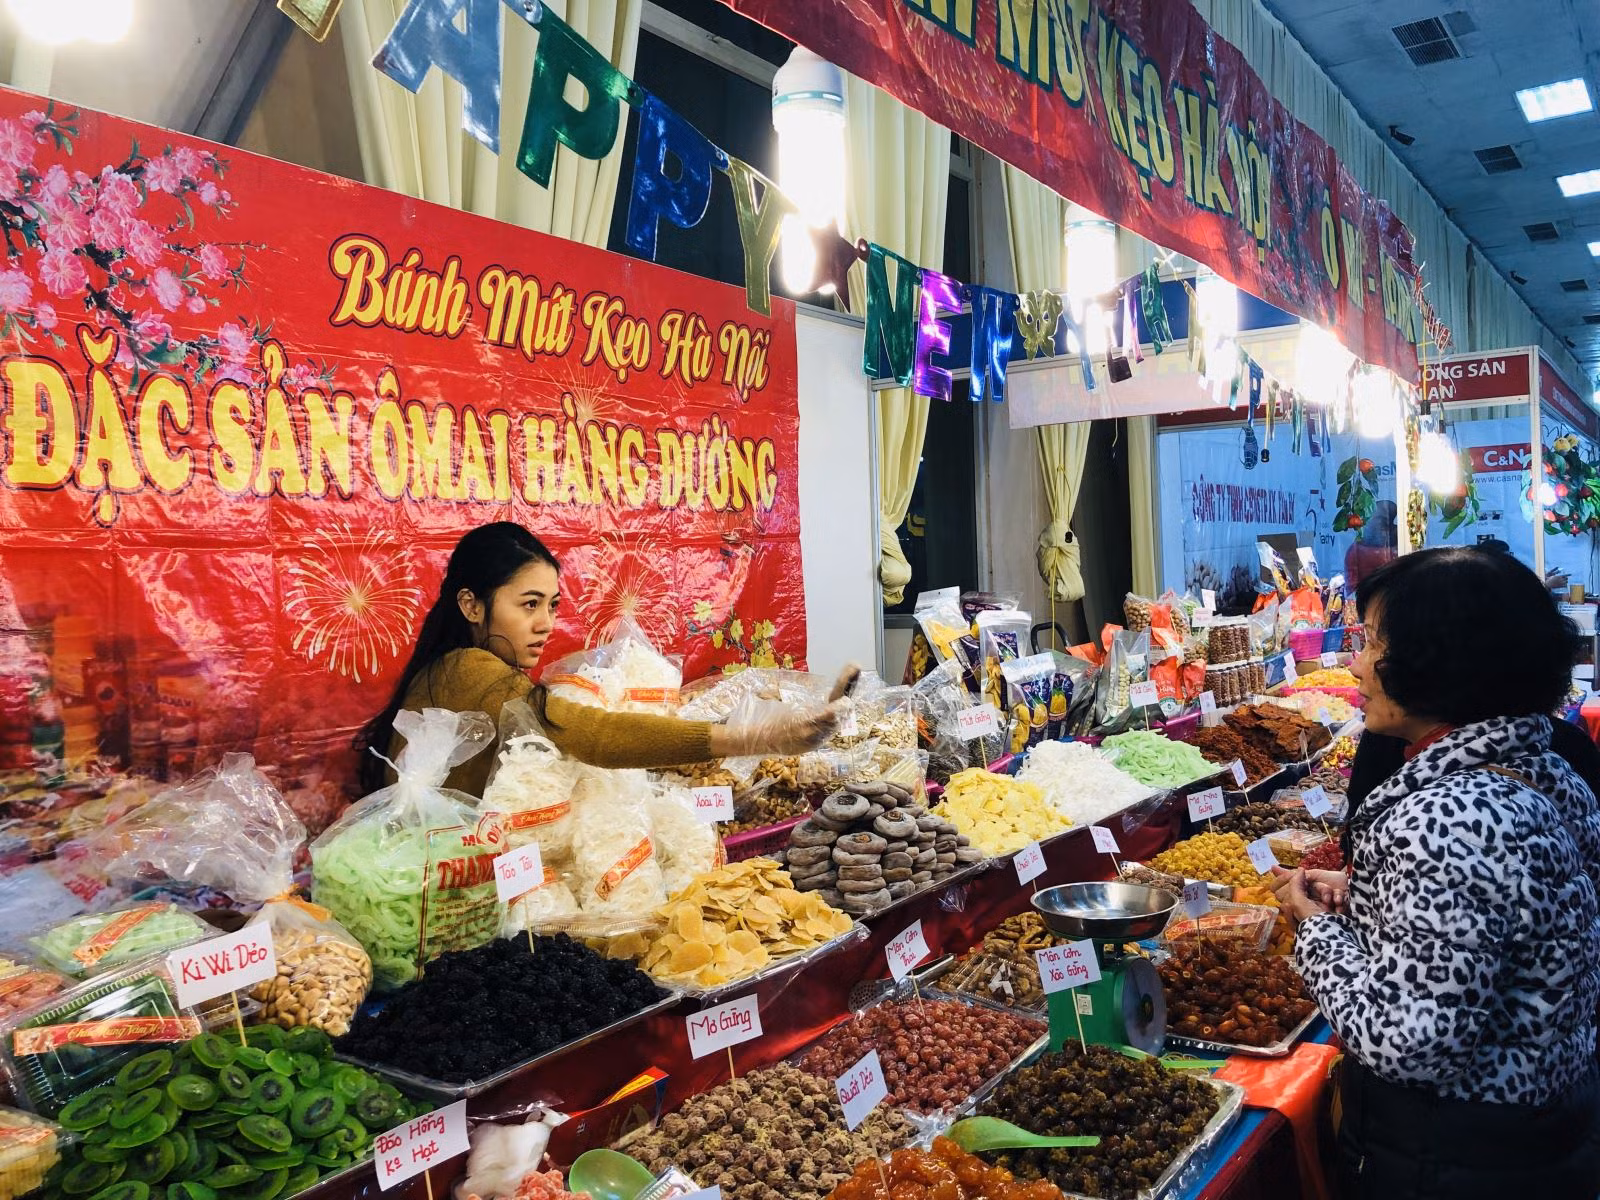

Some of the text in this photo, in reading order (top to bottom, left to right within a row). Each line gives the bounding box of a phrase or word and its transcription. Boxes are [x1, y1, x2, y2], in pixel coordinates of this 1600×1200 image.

[330, 235, 771, 402] Bánh Mứt Kẹo Hà Nội
[1467, 358, 1506, 377] SẢN
[2, 325, 195, 527] ĐẶC
[209, 339, 355, 499] SẢN
[521, 393, 650, 509] HÀNG
[656, 415, 777, 511] ĐƯỜNG
[181, 958, 206, 984] Ki
